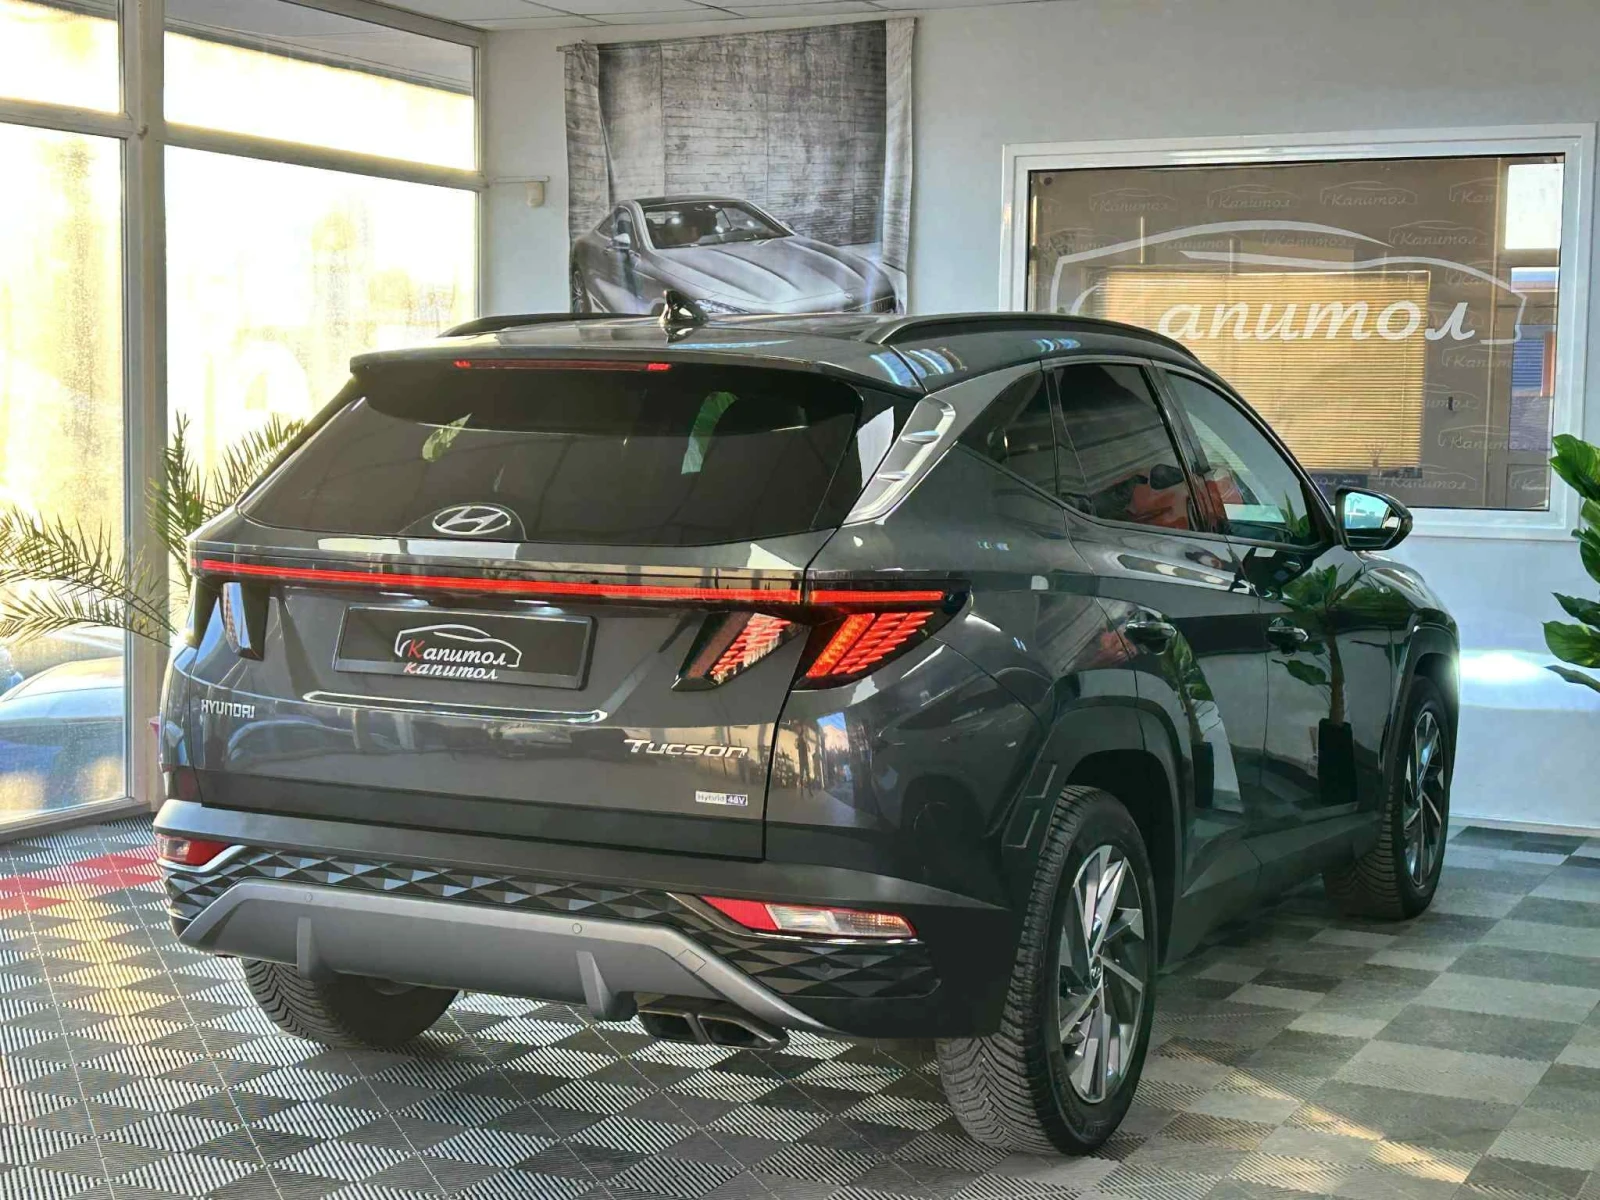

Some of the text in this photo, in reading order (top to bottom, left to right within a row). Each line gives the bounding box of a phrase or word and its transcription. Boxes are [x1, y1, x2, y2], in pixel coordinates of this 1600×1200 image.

[1330, 193, 1408, 207] Капитол
[407, 639, 506, 666] Капитол
[201, 699, 255, 719] HYUNDAI
